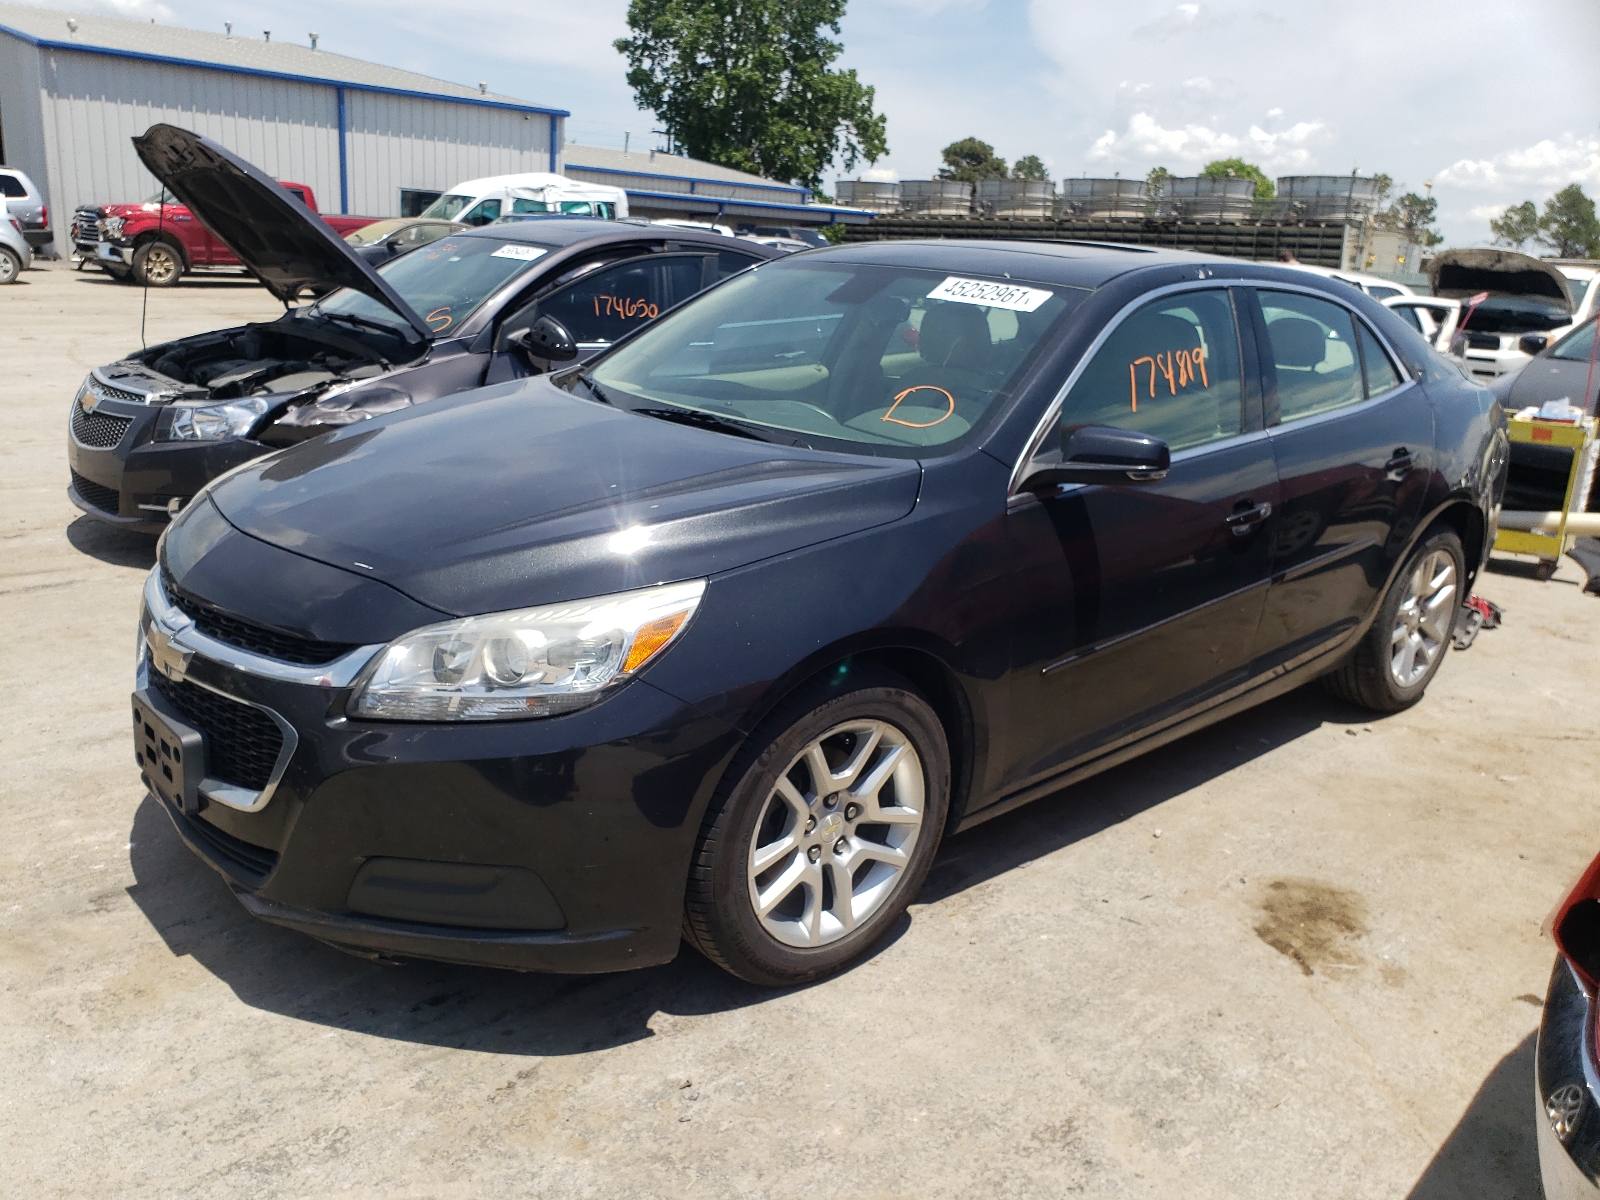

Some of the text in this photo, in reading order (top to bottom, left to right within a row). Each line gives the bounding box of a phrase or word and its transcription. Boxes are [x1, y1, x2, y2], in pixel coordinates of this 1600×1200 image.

[943, 282, 1030, 305] 45252961
[595, 296, 660, 319] 174650
[1130, 348, 1208, 412] 174819
